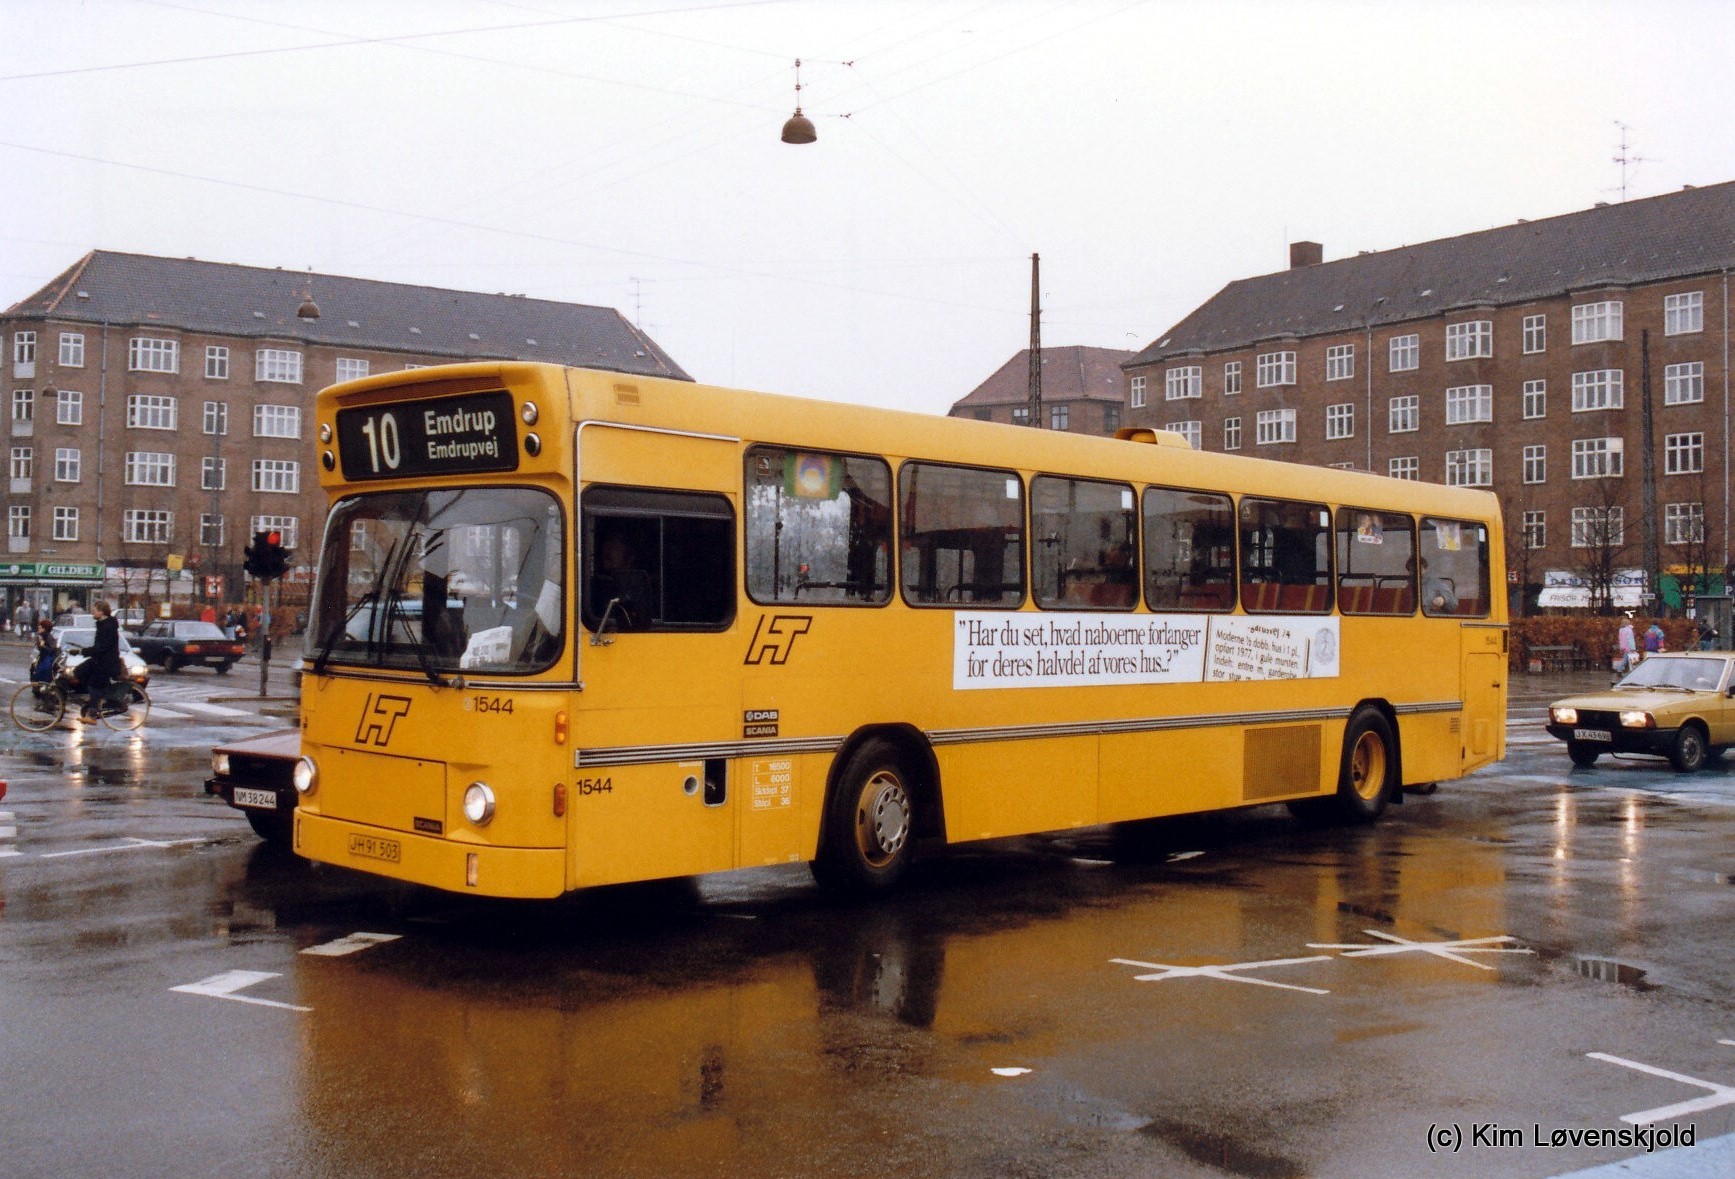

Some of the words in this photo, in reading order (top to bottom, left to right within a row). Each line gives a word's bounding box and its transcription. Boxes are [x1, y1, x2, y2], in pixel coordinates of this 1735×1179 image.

[424, 407, 496, 436] Emdrup
[362, 412, 401, 473] 10
[427, 436, 499, 460] Emdrupvej
[1000, 620, 1019, 646] du
[1023, 624, 1048, 649] set,
[1049, 621, 1081, 646] hvad
[1085, 621, 1145, 646] naboerne
[1148, 621, 1202, 650] forlanger
[1216, 629, 1245, 645] Moderne
[967, 651, 988, 677] for
[992, 650, 1033, 677] deres
[1036, 649, 1085, 676] halvdel
[1088, 649, 1102, 675] af
[1103, 656, 1137, 674] vores
[473, 696, 514, 714] 1544
[754, 711, 778, 720] DAB
[746, 726, 777, 735] SCANIA
[576, 777, 613, 795] 1544
